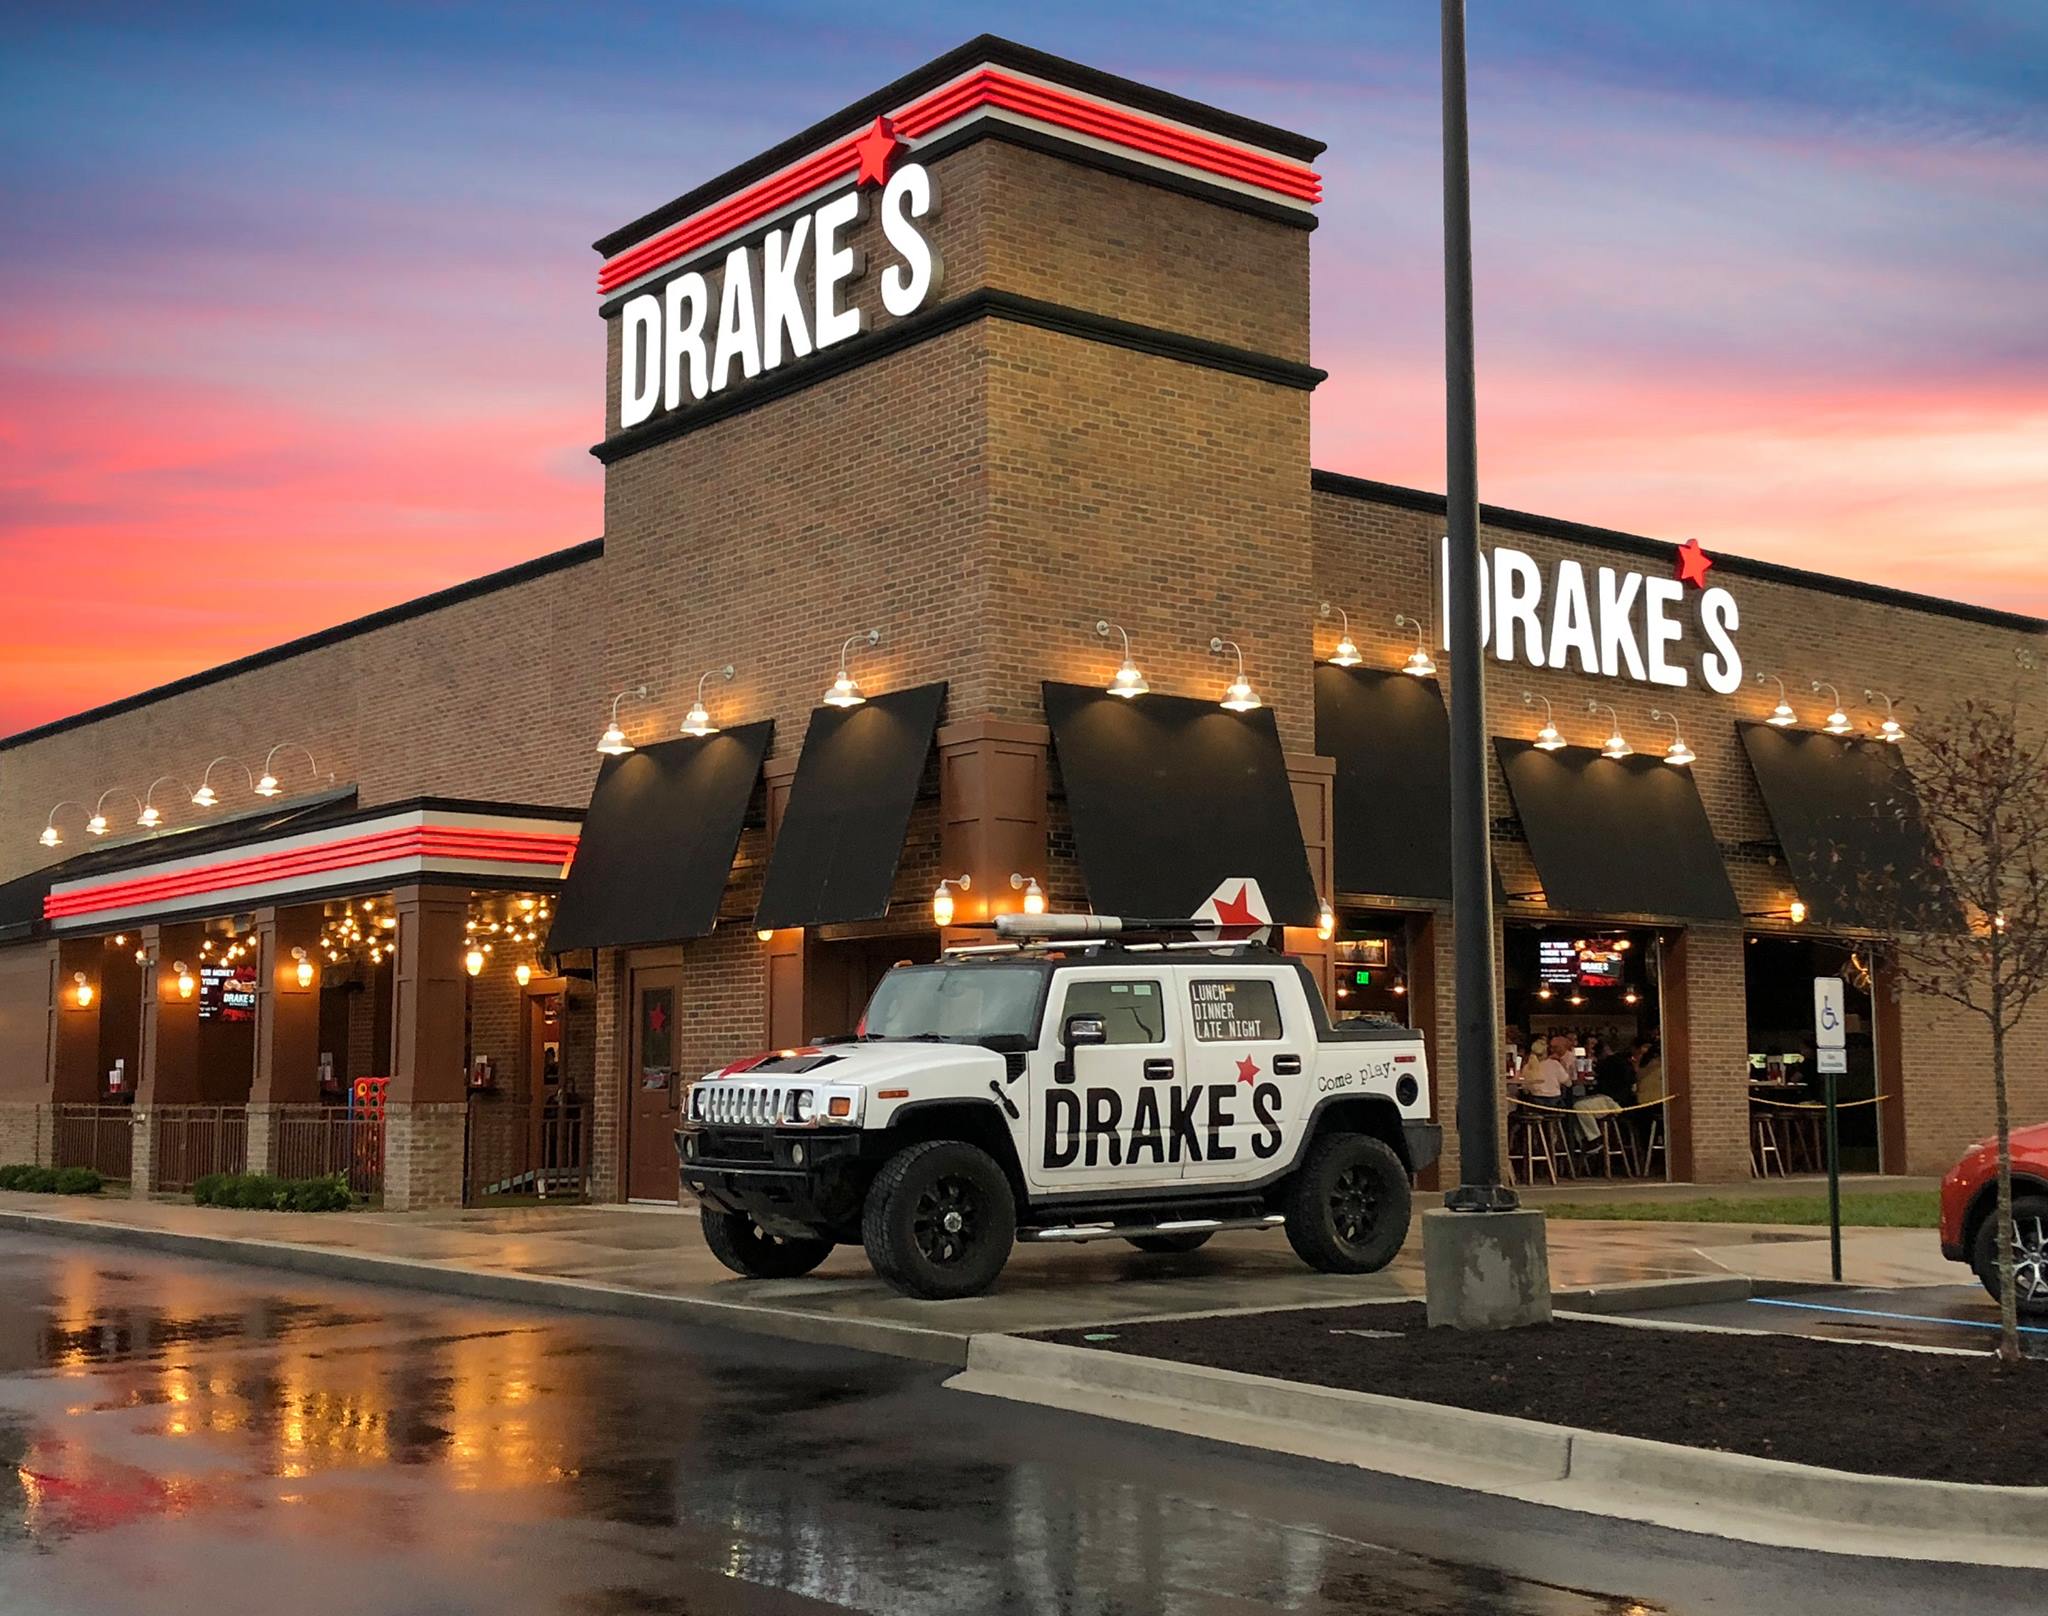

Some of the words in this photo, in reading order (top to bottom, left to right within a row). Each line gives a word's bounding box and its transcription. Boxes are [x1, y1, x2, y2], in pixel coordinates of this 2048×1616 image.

[1191, 984, 1227, 1002] LUNCH
[1194, 1002, 1235, 1020] DINNER
[1195, 1021, 1224, 1039] LATE
[1228, 1020, 1262, 1038] NIGHT
[1318, 1072, 1354, 1093] Come
